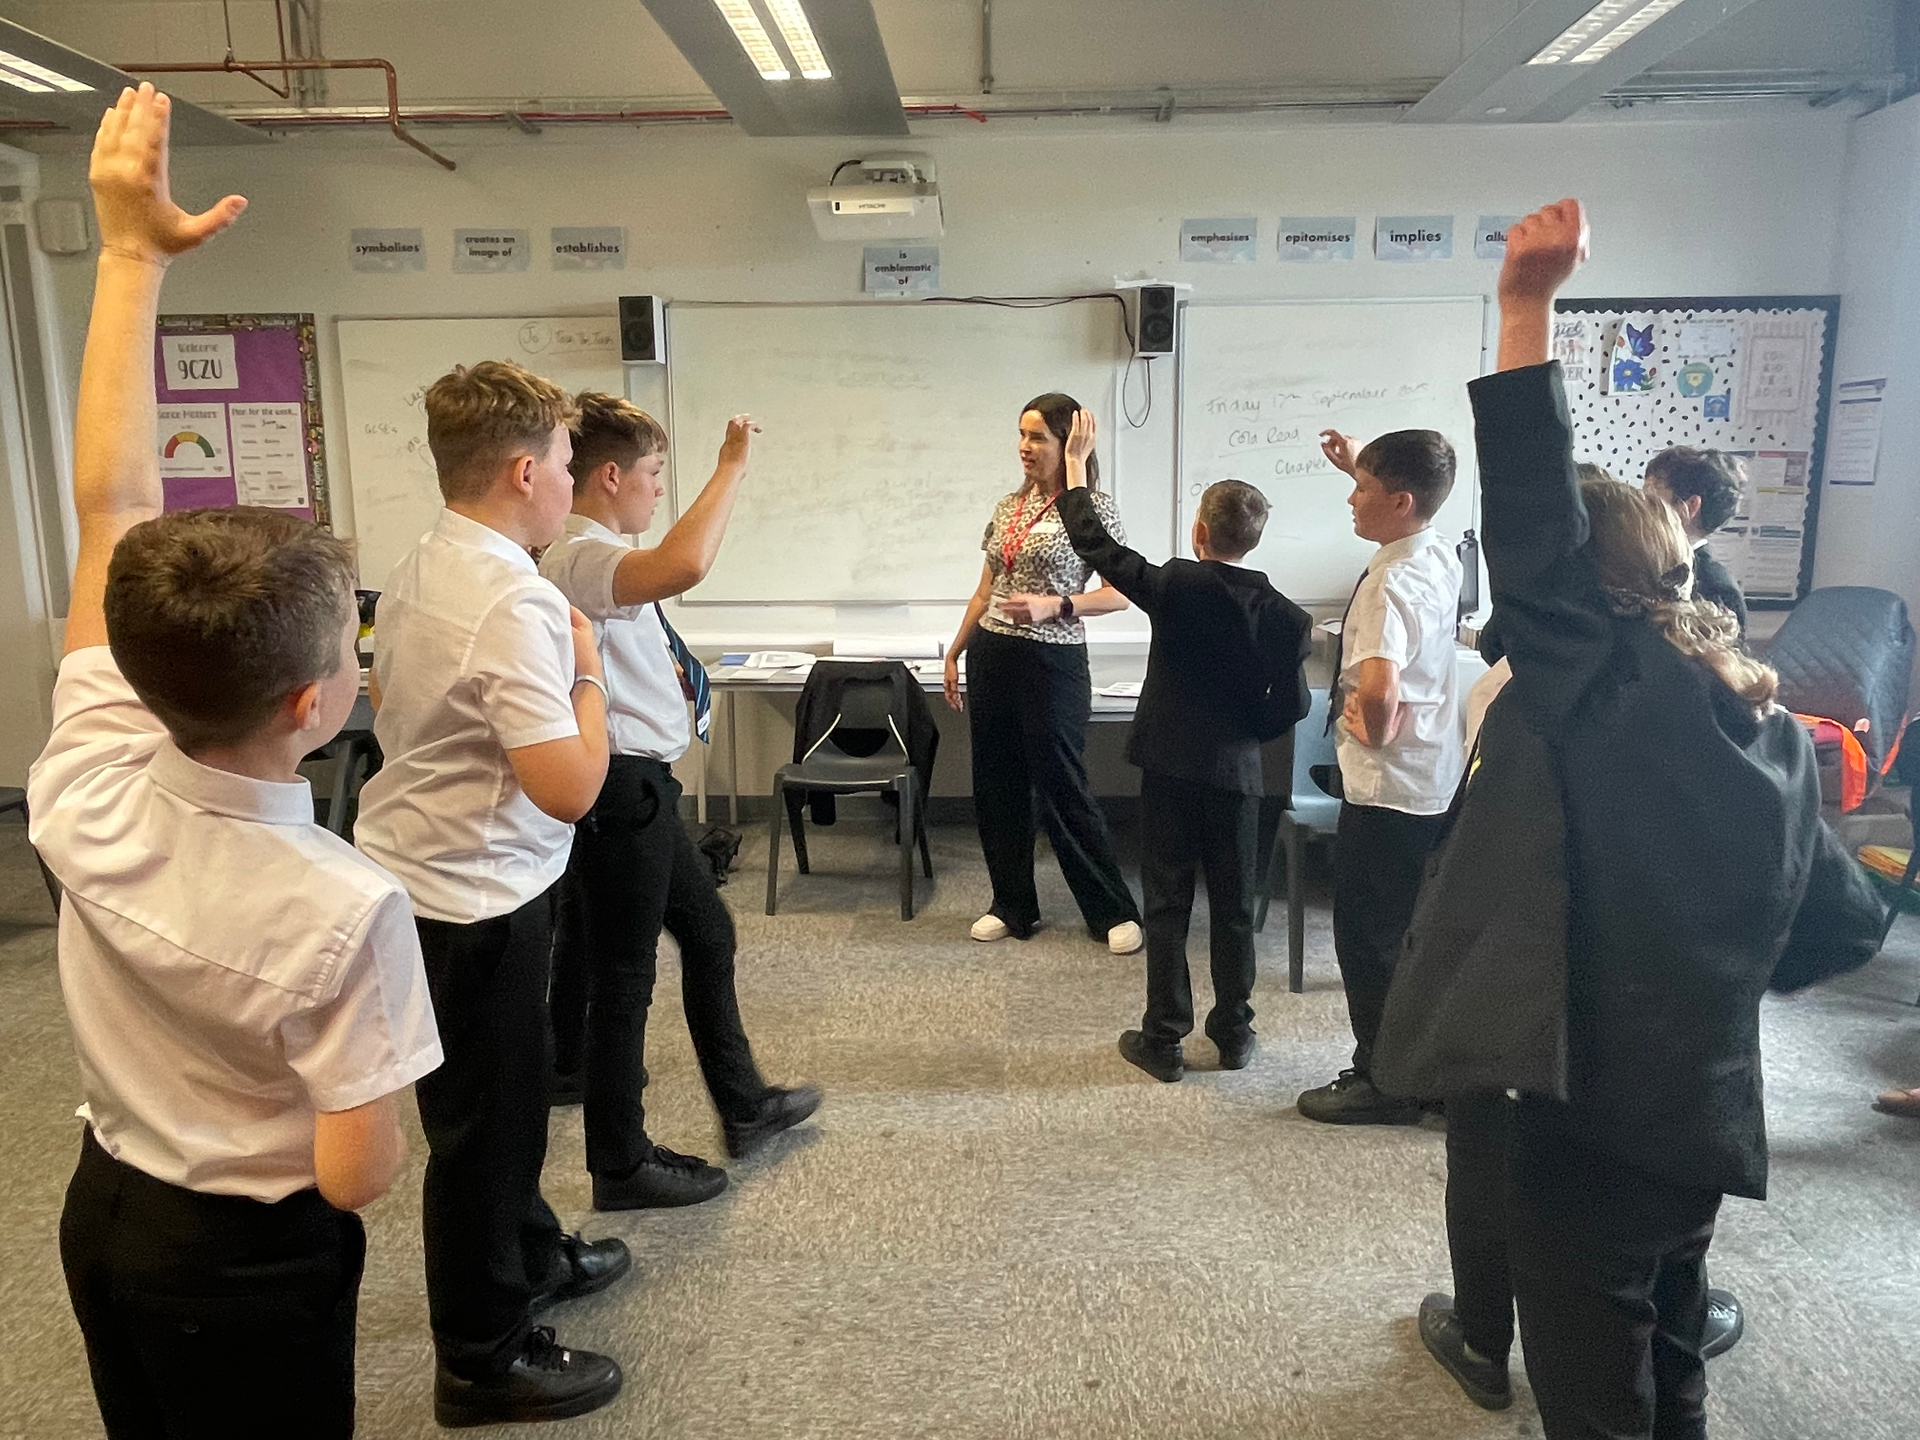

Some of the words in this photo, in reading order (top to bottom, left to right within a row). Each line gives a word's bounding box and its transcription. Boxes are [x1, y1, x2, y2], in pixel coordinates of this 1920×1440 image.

[465, 235, 500, 244] creates
[502, 236, 516, 244] an
[1190, 233, 1250, 244] emphasises
[1285, 232, 1351, 244] epitomises
[1390, 229, 1442, 245] implies
[1485, 230, 1508, 242] allu
[355, 242, 420, 255] symbolises
[468, 247, 500, 258] image
[502, 247, 513, 256] of
[555, 242, 620, 254] establishes
[898, 249, 907, 259] is
[874, 263, 932, 272] emblematic
[898, 276, 909, 285] of
[177, 343, 219, 353] Welcome
[177, 358, 223, 380] 9CZU
[1205, 396, 1262, 422] Friday
[1312, 388, 1389, 408] September
[1228, 429, 1258, 448] Cold
[1275, 458, 1328, 475] Chapter
